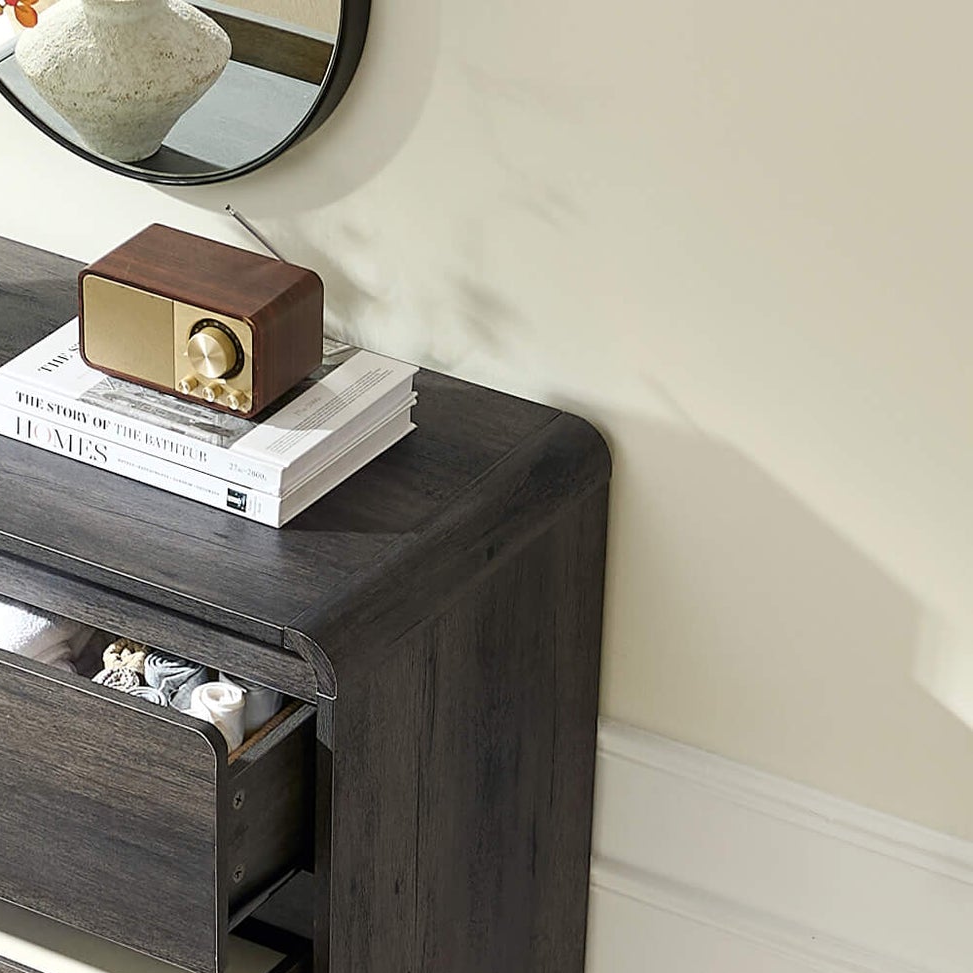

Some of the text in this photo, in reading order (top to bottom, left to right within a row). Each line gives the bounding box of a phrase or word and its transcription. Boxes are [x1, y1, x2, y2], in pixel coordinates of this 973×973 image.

[38, 353, 73, 371] THE
[16, 391, 208, 463] THE STORY OF THE BATHTUB
[16, 416, 108, 465] HOMES
